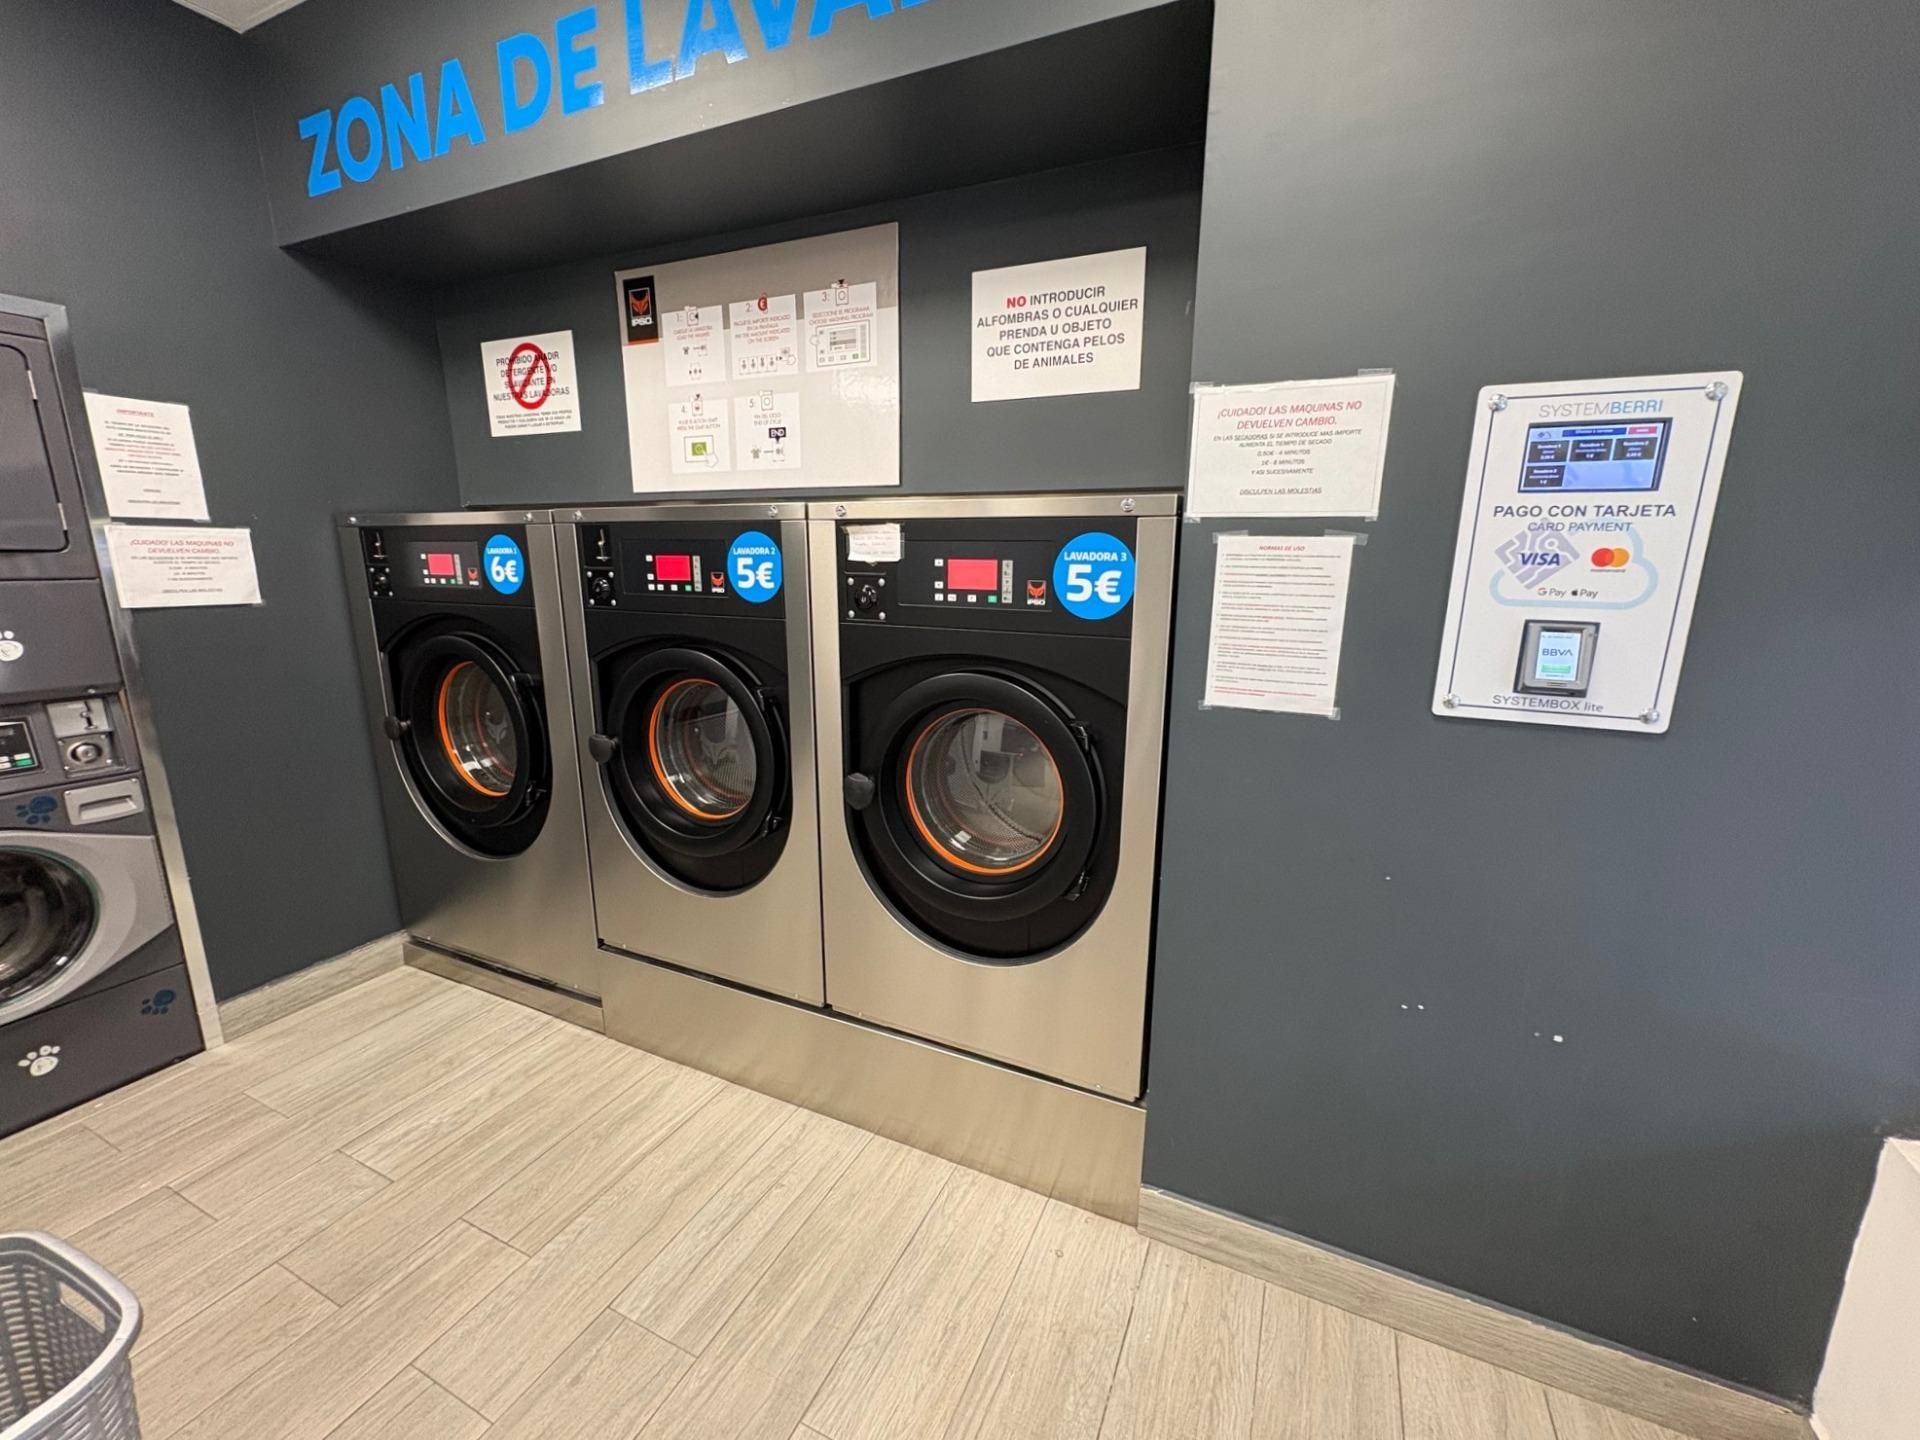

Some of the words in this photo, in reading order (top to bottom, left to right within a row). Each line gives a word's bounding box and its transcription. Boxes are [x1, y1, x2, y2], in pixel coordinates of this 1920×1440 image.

[298, 58, 486, 197] ZONA
[496, 4, 605, 136] DE
[1006, 296, 1027, 309] NO
[1030, 286, 1105, 306] INTRODUCIR
[977, 309, 1049, 328] ALFOMBRAS
[1053, 308, 1062, 319] O
[1065, 298, 1139, 318] CUALQUIER
[999, 326, 1047, 340] PRENDA
[1051, 324, 1059, 335] U
[1062, 318, 1112, 334] OBJETO
[986, 345, 1010, 357] QUE
[1014, 338, 1080, 354] CONTENGA
[1083, 333, 1125, 348] PELOS
[1014, 358, 1029, 370] DE
[1032, 352, 1094, 368] ANIMALES
[1217, 406, 1266, 419] ¡CUIDADO!
[1268, 405, 1287, 415] LAS
[1289, 401, 1343, 414] MAQUINAS
[1346, 400, 1362, 410] NO
[1538, 399, 1663, 418] SYSTEMBERRI
[1237, 418, 1293, 429] DEVUELVEN
[1295, 416, 1337, 427] CAMBIO.
[771, 429, 785, 437] END
[1493, 505, 1542, 518] PAGO
[1547, 505, 1587, 517] CON
[1593, 504, 1676, 517] TARJETA
[1527, 522, 1565, 532] CARD
[1567, 521, 1632, 532] PAYMENT
[733, 547, 769, 555] LAVADORA
[770, 547, 776, 555] 2
[1063, 551, 1118, 562] LAVADORA
[1120, 551, 1127, 562] 3
[1520, 552, 1561, 566] VISA
[491, 556, 519, 583] 6€
[737, 557, 775, 589] 5€
[1066, 564, 1122, 603] 5€
[1549, 587, 1567, 598] Pay
[1580, 588, 1599, 599] Pay
[1542, 648, 1573, 657] BBVA
[1492, 694, 1580, 711] SYSTEMBOX
[1584, 702, 1604, 712] lite
